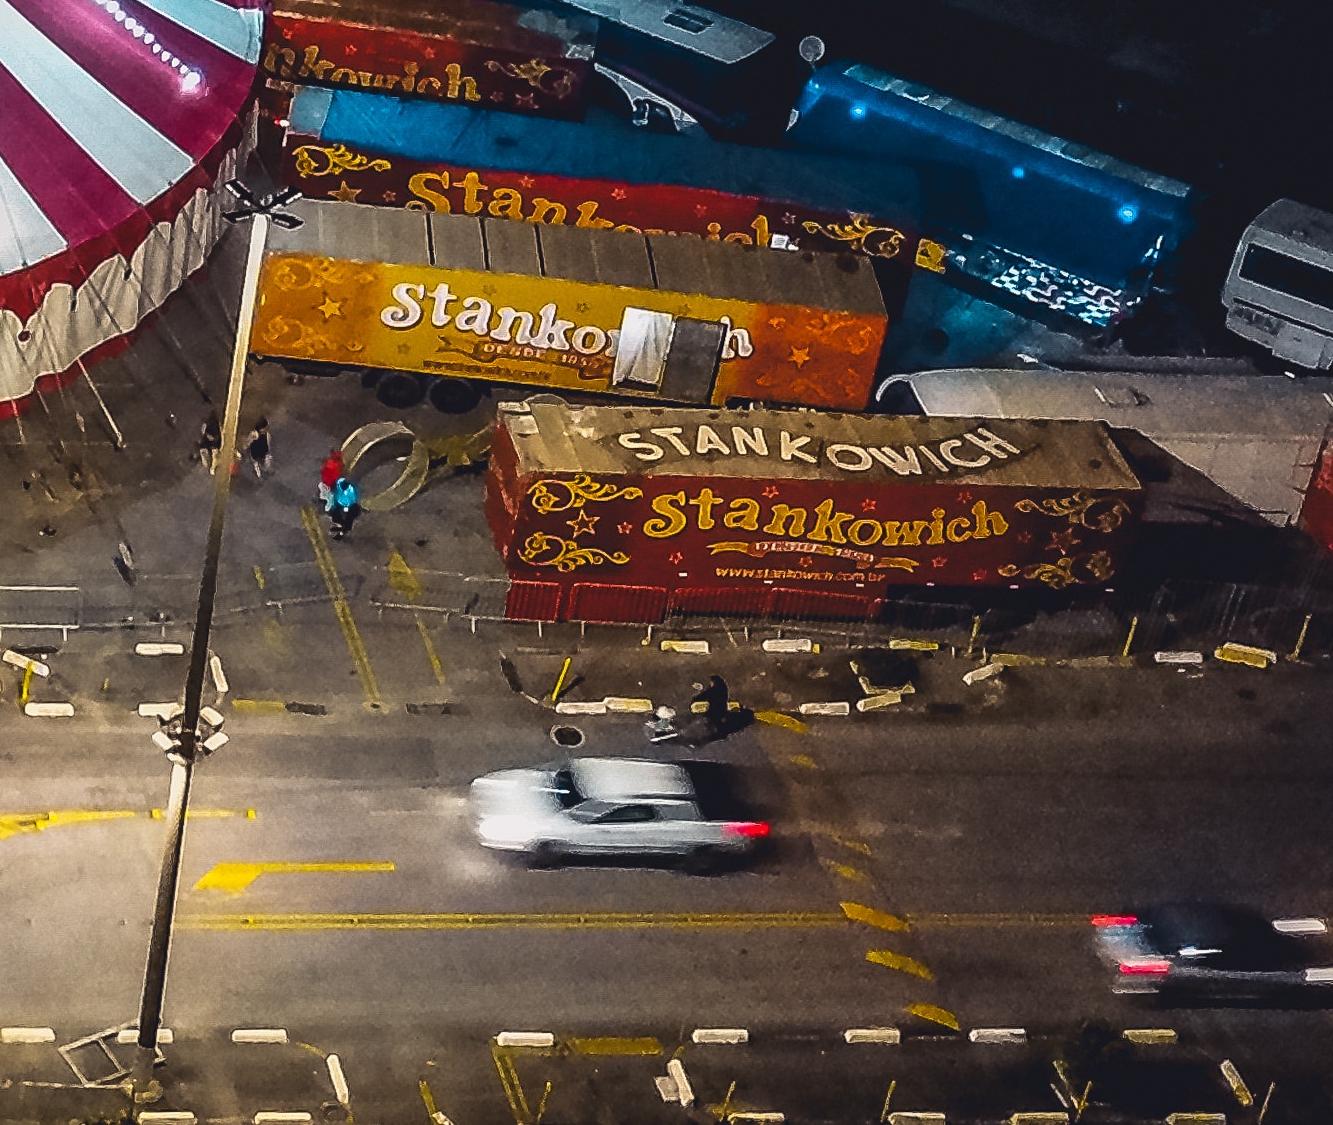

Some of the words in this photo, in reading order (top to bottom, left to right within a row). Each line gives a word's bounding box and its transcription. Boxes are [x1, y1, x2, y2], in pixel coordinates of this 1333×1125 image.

[380, 282, 754, 360] Stankoh
[615, 423, 1021, 476] STANKOWICH
[642, 487, 1009, 547] Stankowich
